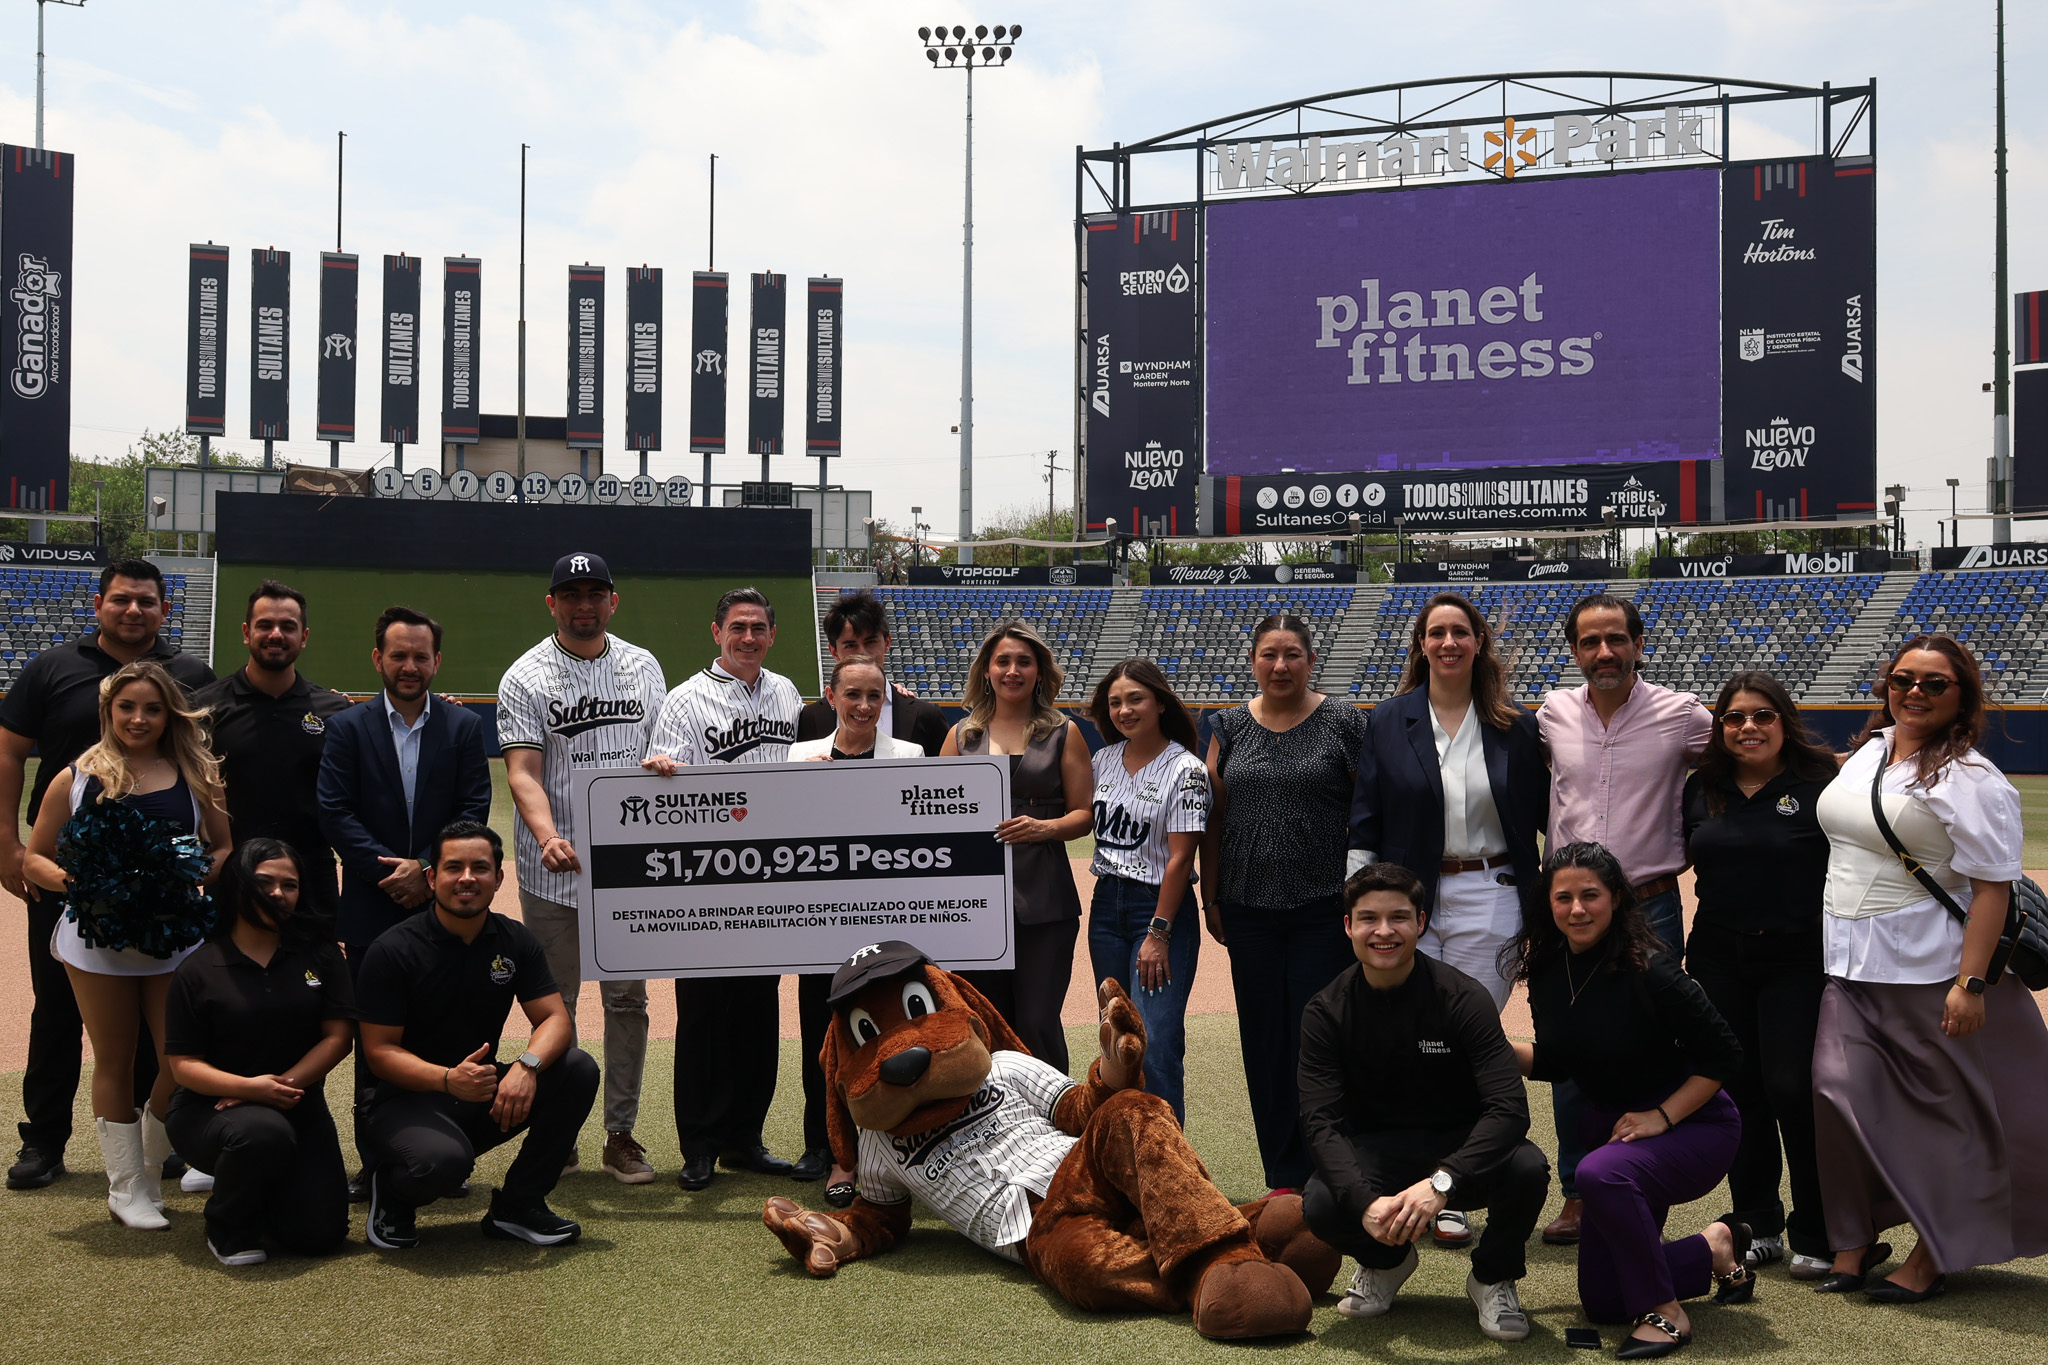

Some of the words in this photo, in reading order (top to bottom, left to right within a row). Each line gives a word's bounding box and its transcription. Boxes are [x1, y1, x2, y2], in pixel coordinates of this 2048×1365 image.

[1214, 126, 1469, 189] Walmart
[1554, 106, 1702, 165] Park
[1761, 218, 1795, 240] Tim
[1743, 243, 1815, 264] Hortons
[1120, 269, 1165, 285] PETRO
[1123, 282, 1162, 296] SEVEN
[1316, 271, 1543, 348] planet
[50, 305, 60, 360] Incondicional
[258, 306, 283, 381] SULTANES
[388, 312, 414, 386] SULTANES
[633, 322, 657, 393] SULTANES
[756, 328, 779, 398] SULTANES
[1133, 360, 1191, 371] WYNDHAM
[1347, 331, 1595, 385] fitness
[50, 363, 59, 384] Amor
[1133, 372, 1168, 380] GARDEN
[1133, 380, 1169, 388] Monterrey
[384, 474, 394, 490] 1
[422, 475, 432, 490] 5
[459, 476, 469, 492] 7
[495, 477, 505, 493] 9
[527, 478, 546, 495] 13
[563, 479, 581, 496] 17
[599, 480, 617, 497] 20
[634, 481, 653, 498] 21
[669, 482, 688, 498] 22
[1610, 490, 1656, 504] TRIBUS
[1256, 510, 1386, 526] SultanesOfcial
[1403, 507, 1588, 521] www.sultanes.com.mx
[1622, 503, 1666, 518] FUEGO
[21, 548, 95, 561] VIDUSA
[1785, 551, 1854, 574] Mobil
[1958, 546, 2048, 568] DUARS
[954, 567, 1020, 577] TOPGOLF
[1169, 566, 1225, 585] Méndez
[1229, 565, 1251, 585] Jr.
[1528, 561, 1569, 579] Clamato
[548, 683, 576, 693] BBVA
[547, 695, 644, 728] Sultanes
[1182, 778, 1207, 789] REIN
[655, 791, 748, 808] SULTANES
[901, 784, 965, 805] planet
[910, 800, 979, 816] fitness
[1182, 798, 1208, 811] Mob
[645, 845, 839, 883] $1,700,925
[849, 843, 952, 871] Pesos
[612, 909, 686, 921] DESTINADO
[688, 908, 696, 918] A
[699, 906, 754, 918] BRINDAR
[757, 904, 805, 916] EQUIPO
[808, 900, 905, 914] ESPECIALIZADO
[908, 899, 934, 911] QUE
[937, 898, 988, 910] MEJORE
[630, 923, 645, 933] LA
[647, 920, 721, 932] MOVILIDAD,
[724, 915, 826, 930] REHABILITACIÓN
[829, 917, 837, 926] Y
[840, 914, 907, 926] BIENESTAR
[910, 913, 926, 924] DE
[929, 911, 971, 923] NIÑOS.
[1418, 1040, 1444, 1048] planet
